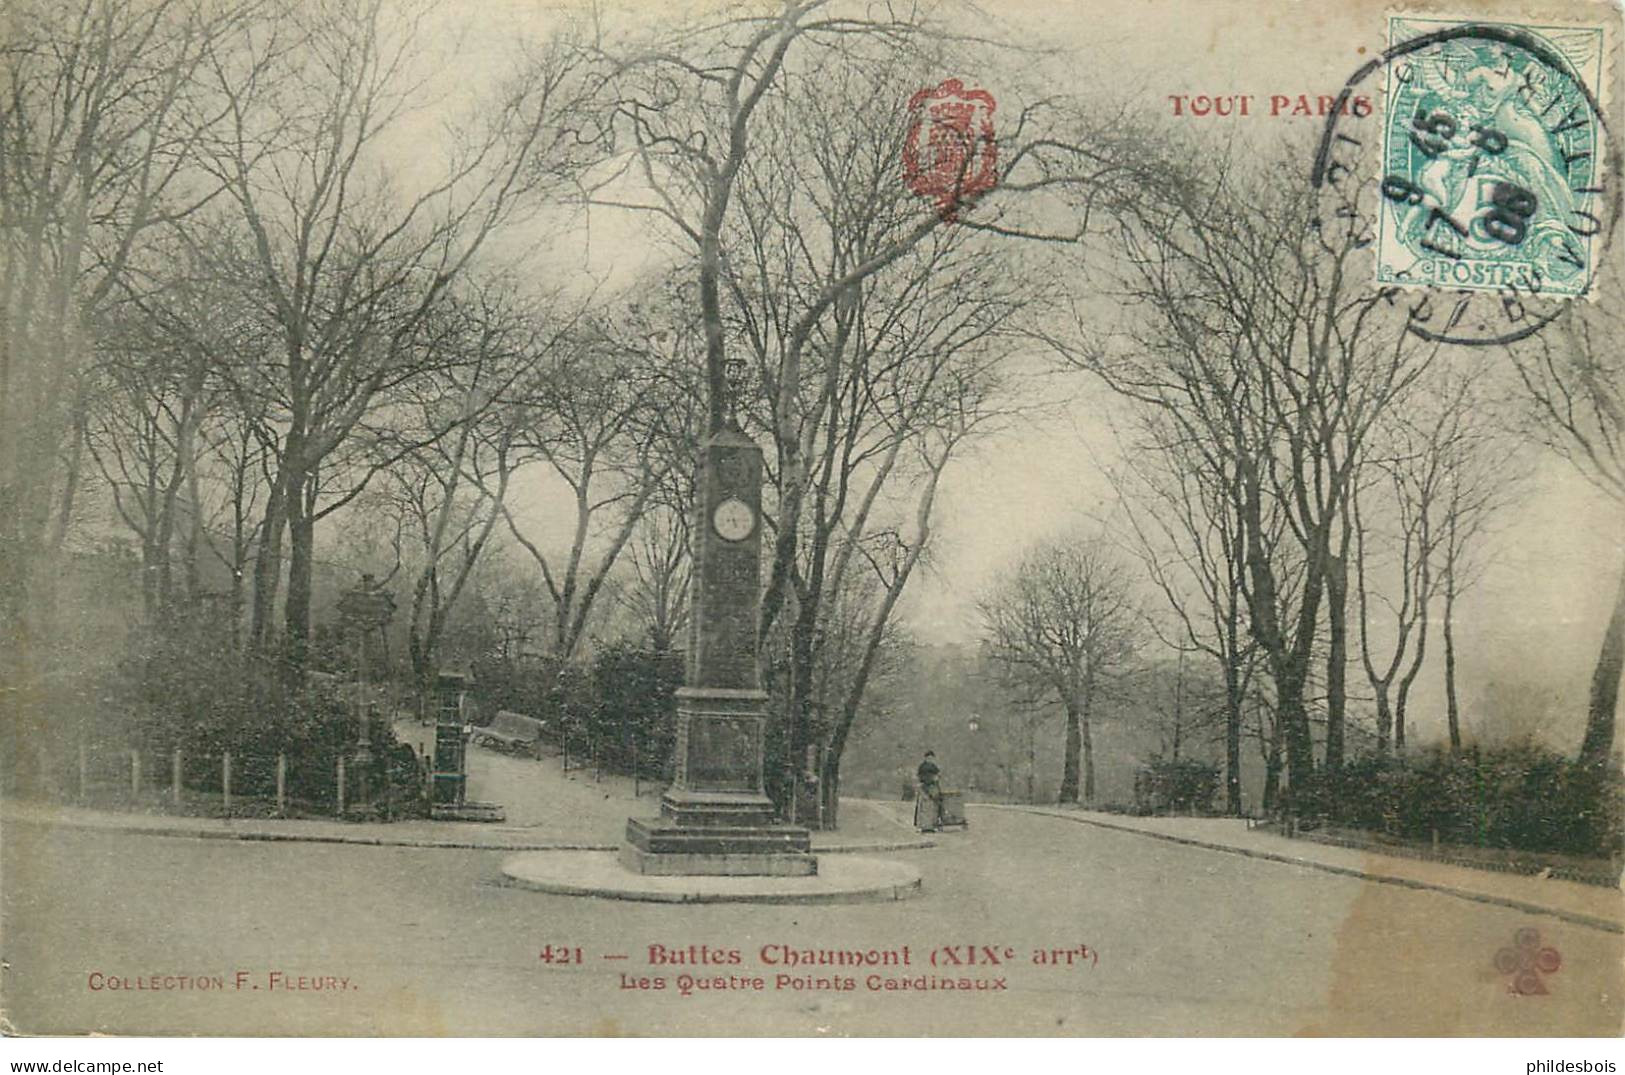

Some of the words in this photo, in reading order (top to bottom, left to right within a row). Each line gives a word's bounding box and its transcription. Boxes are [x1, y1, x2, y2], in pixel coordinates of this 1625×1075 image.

[1168, 94, 1250, 117] TOUT
[1268, 94, 1374, 118] PARIS
[1435, 258, 1531, 288] POSTES
[540, 944, 584, 964] 421
[648, 943, 742, 966] Buttes
[758, 944, 911, 967] Chaumont
[88, 971, 224, 992] COLLECTION
[236, 971, 260, 992] F.
[269, 971, 359, 992] FLEURY.
[620, 972, 666, 990] Les
[677, 972, 765, 996] Quatre
[776, 973, 855, 992] Points
[866, 974, 1008, 992] Cardinaux
